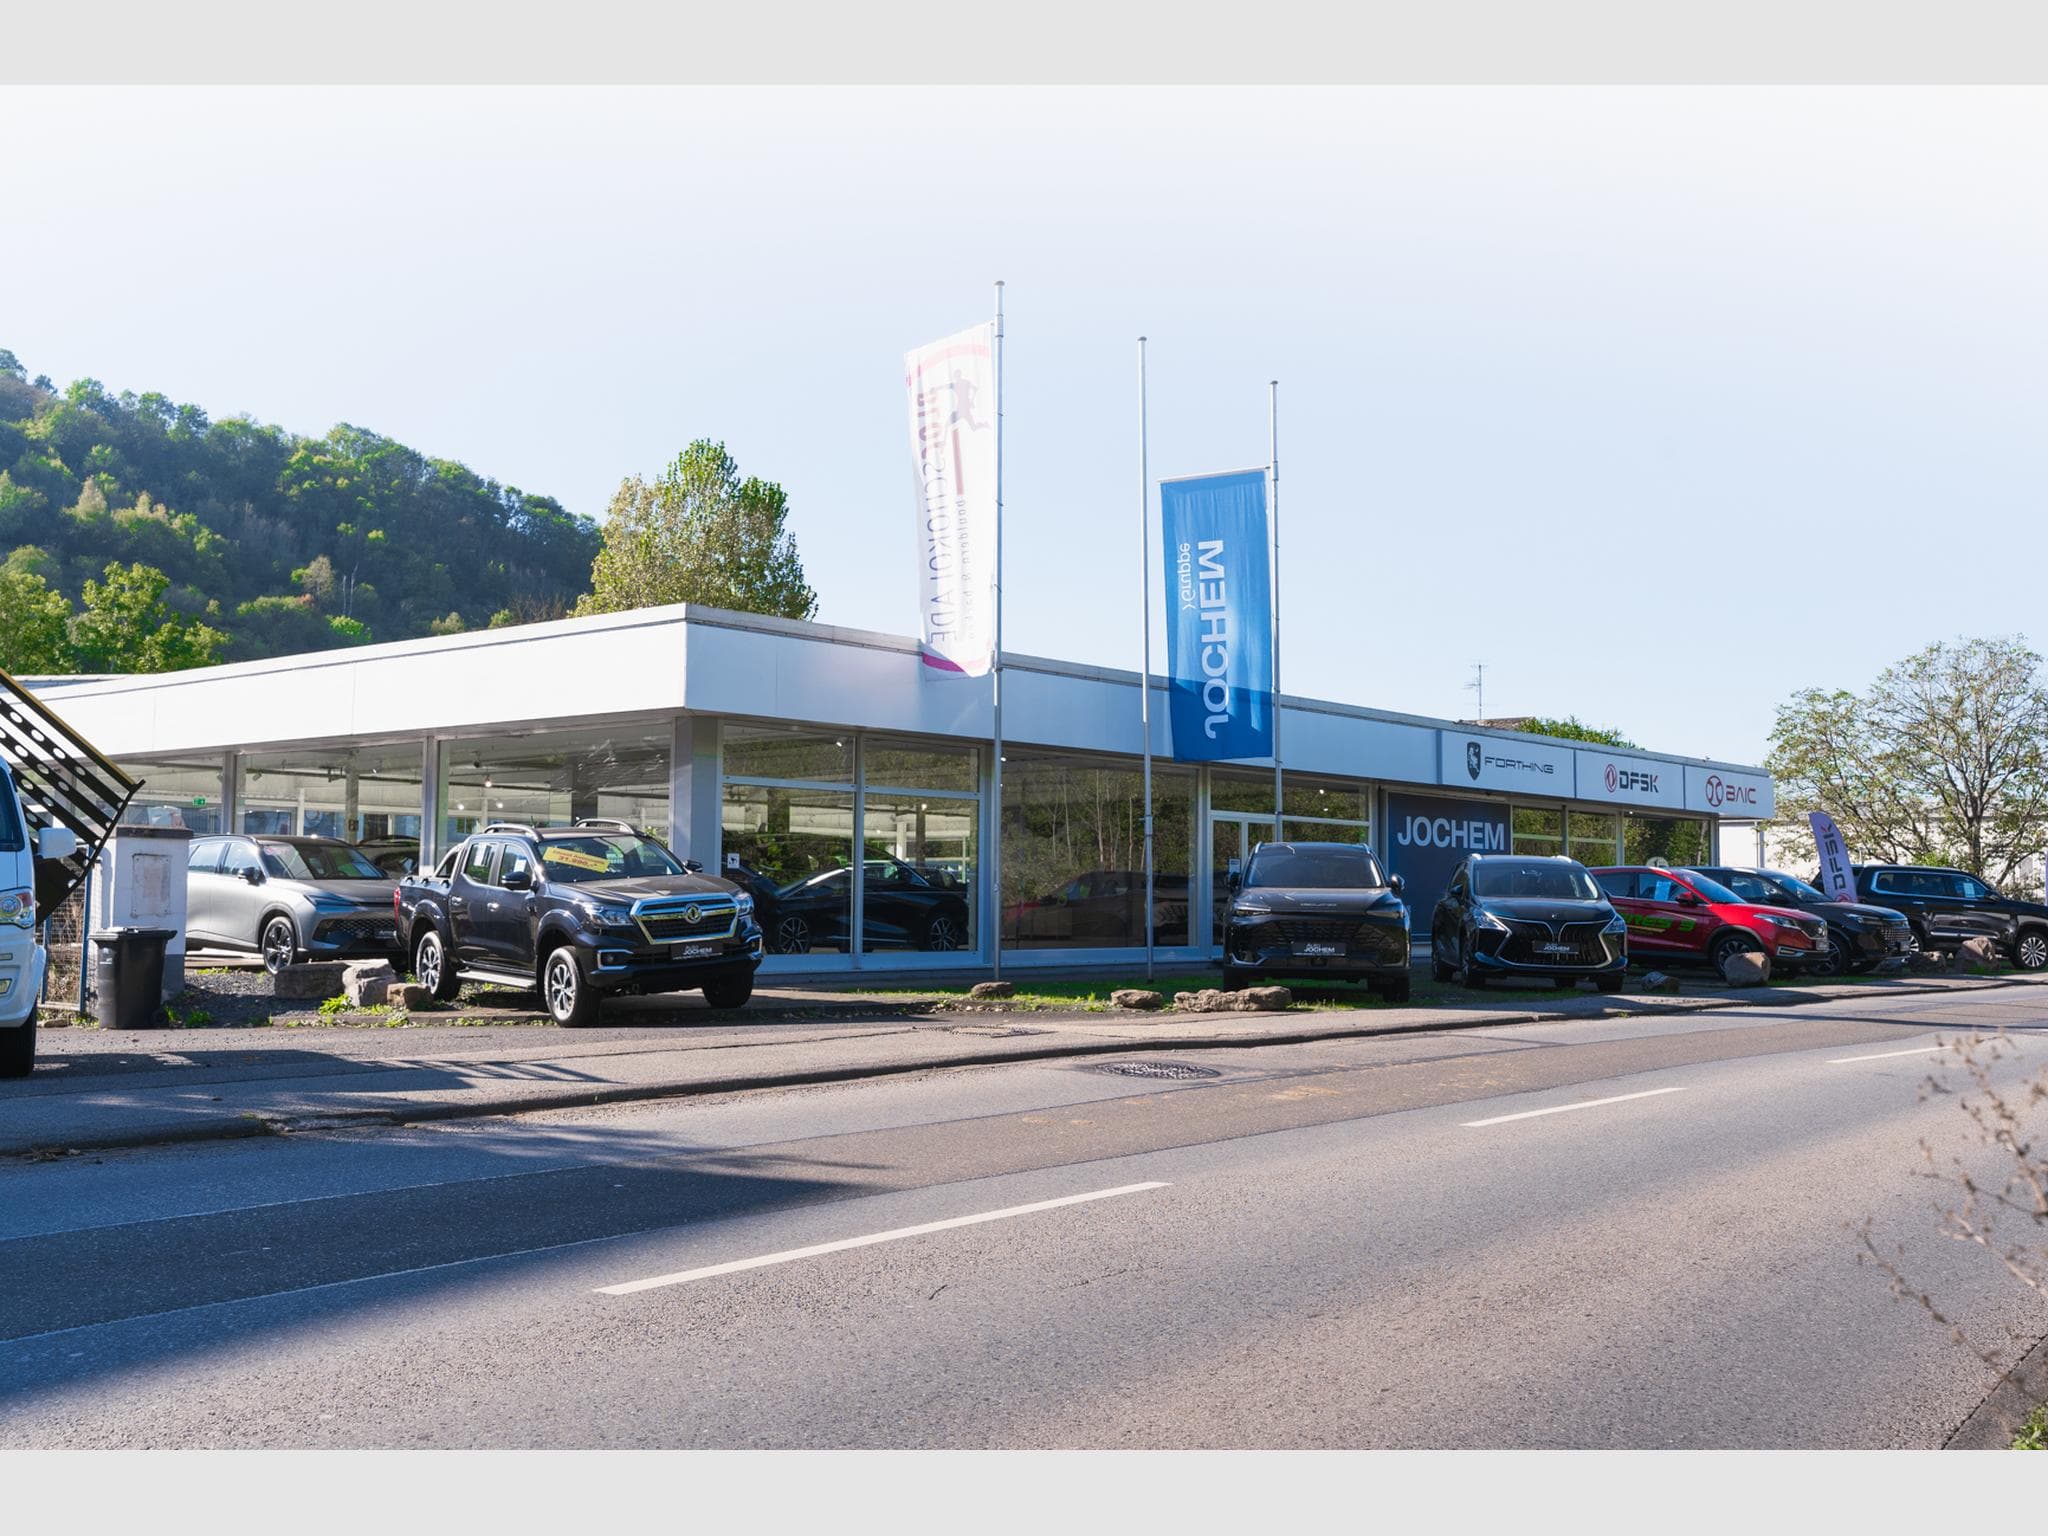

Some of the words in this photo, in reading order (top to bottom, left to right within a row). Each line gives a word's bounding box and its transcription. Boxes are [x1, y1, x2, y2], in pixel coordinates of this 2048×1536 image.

[1484, 756, 1554, 774] FORTHING
[1619, 770, 1659, 793] DFSK
[1725, 785, 1757, 804] BAIC
[1397, 816, 1504, 850] JOCHEM
[1820, 824, 1847, 890] DFSK
